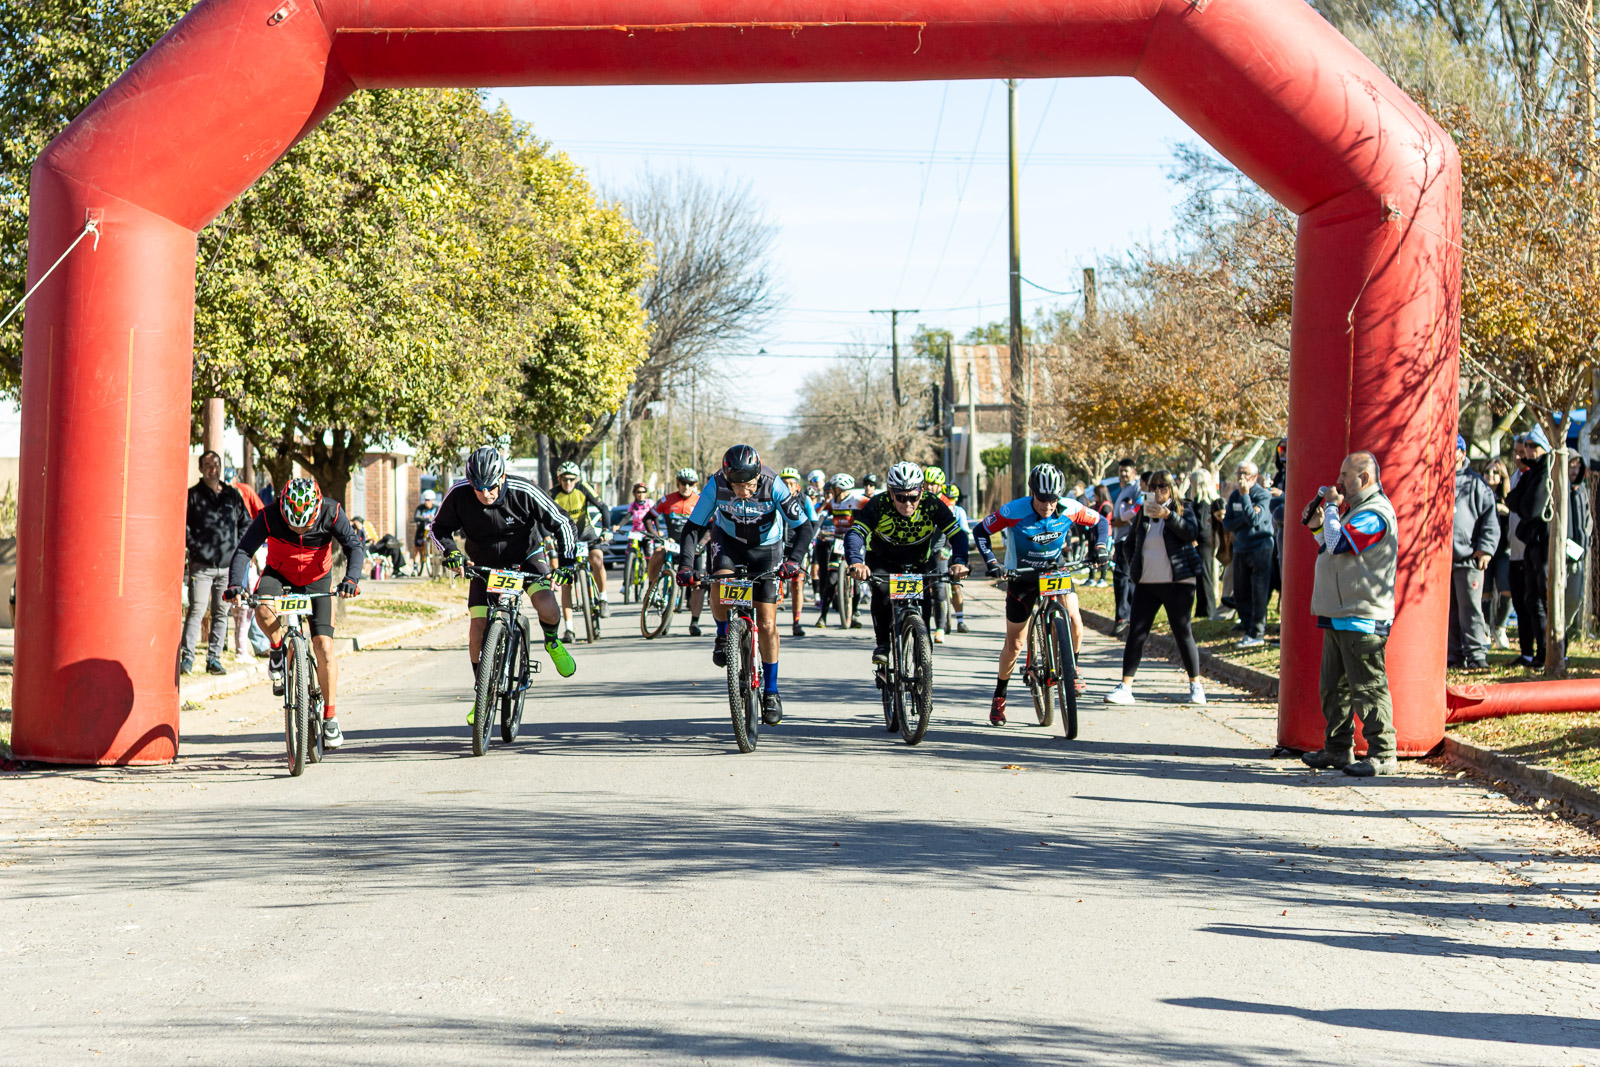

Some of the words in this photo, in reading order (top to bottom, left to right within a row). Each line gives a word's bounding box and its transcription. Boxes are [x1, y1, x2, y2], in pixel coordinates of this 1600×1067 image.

[493, 575, 518, 589] 35
[896, 580, 918, 593] 93
[1046, 578, 1062, 591] 51
[724, 585, 749, 600] 167
[280, 599, 307, 610] 160
